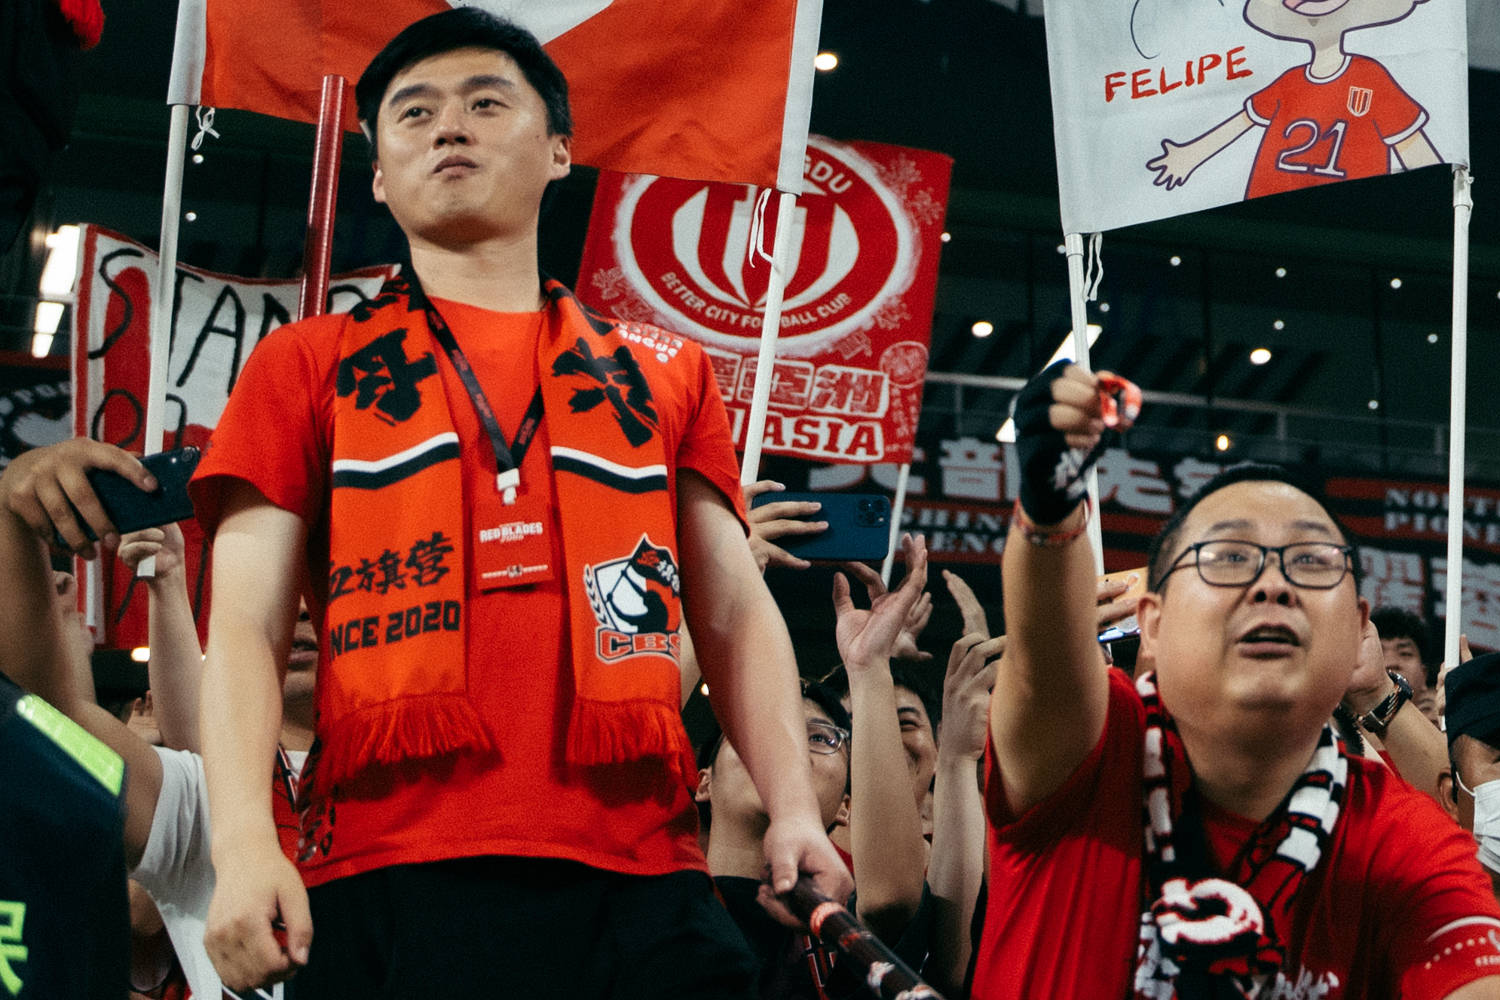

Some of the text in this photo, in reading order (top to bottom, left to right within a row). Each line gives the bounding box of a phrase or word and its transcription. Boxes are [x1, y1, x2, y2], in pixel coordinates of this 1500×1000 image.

[1105, 46, 1253, 102] FELIPE
[1277, 121, 1350, 177] 21
[660, 272, 851, 329] BETTER CITY FOBALL CLUB
[386, 600, 461, 646] 2020
